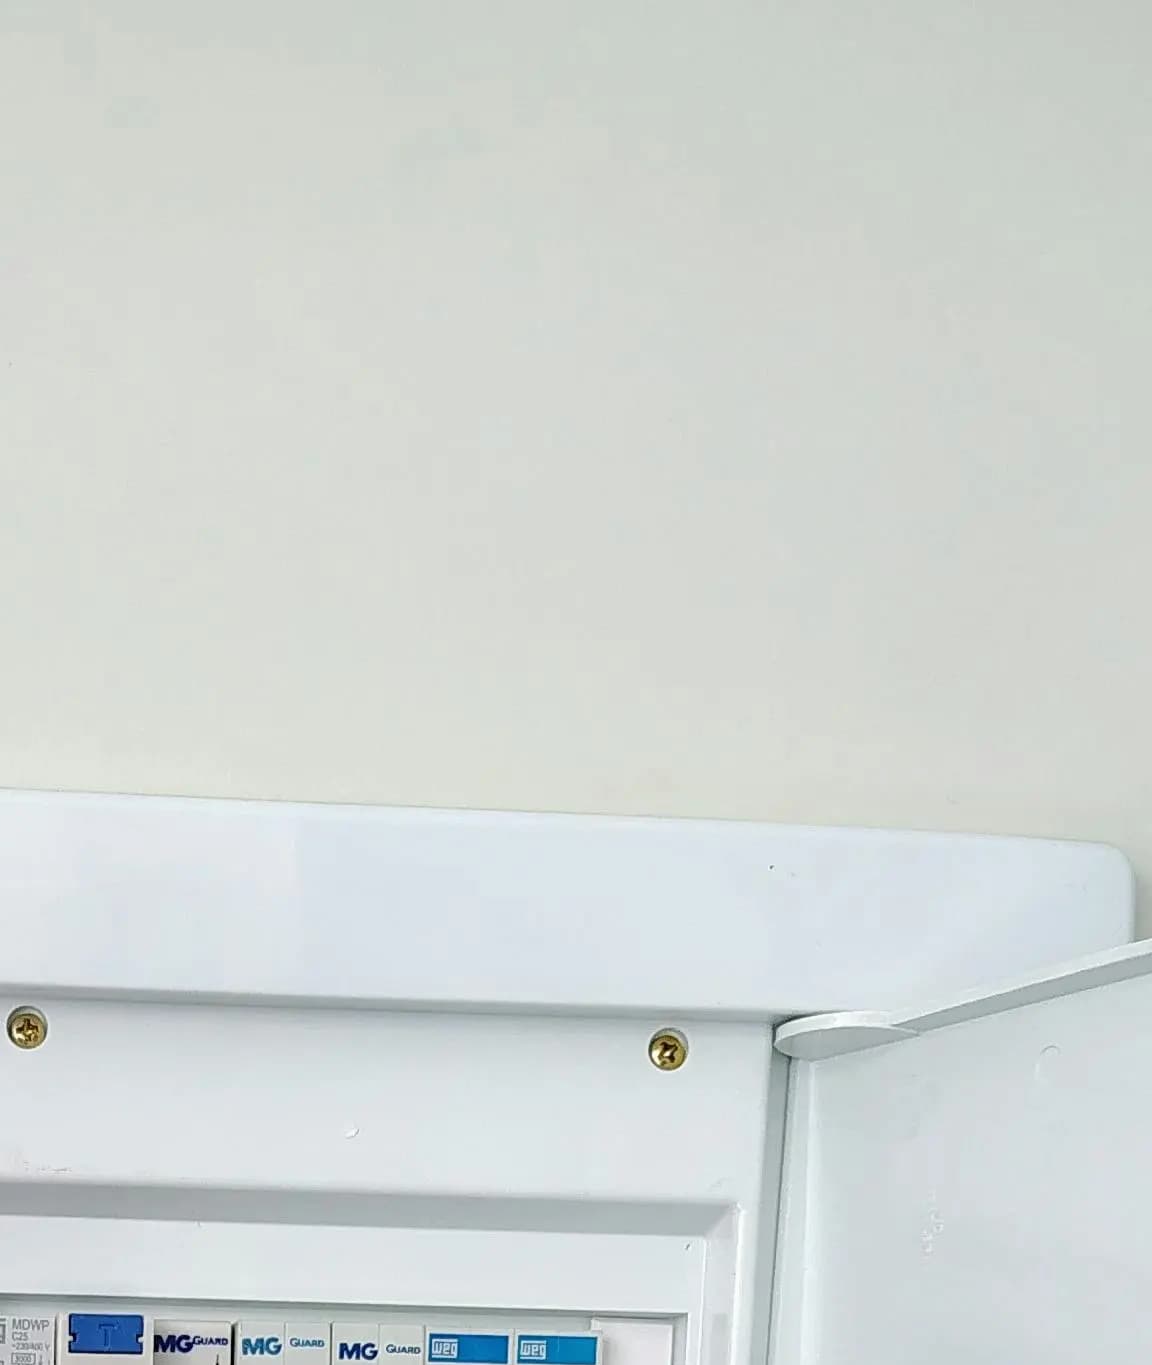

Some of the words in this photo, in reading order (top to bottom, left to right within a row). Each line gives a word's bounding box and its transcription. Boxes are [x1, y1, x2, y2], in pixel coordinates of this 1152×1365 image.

[12, 1319, 50, 1331] MDWP
[12, 1331, 29, 1341] C25
[154, 1334, 194, 1353] MG
[241, 1337, 282, 1355] MG
[338, 1343, 378, 1361] MG
